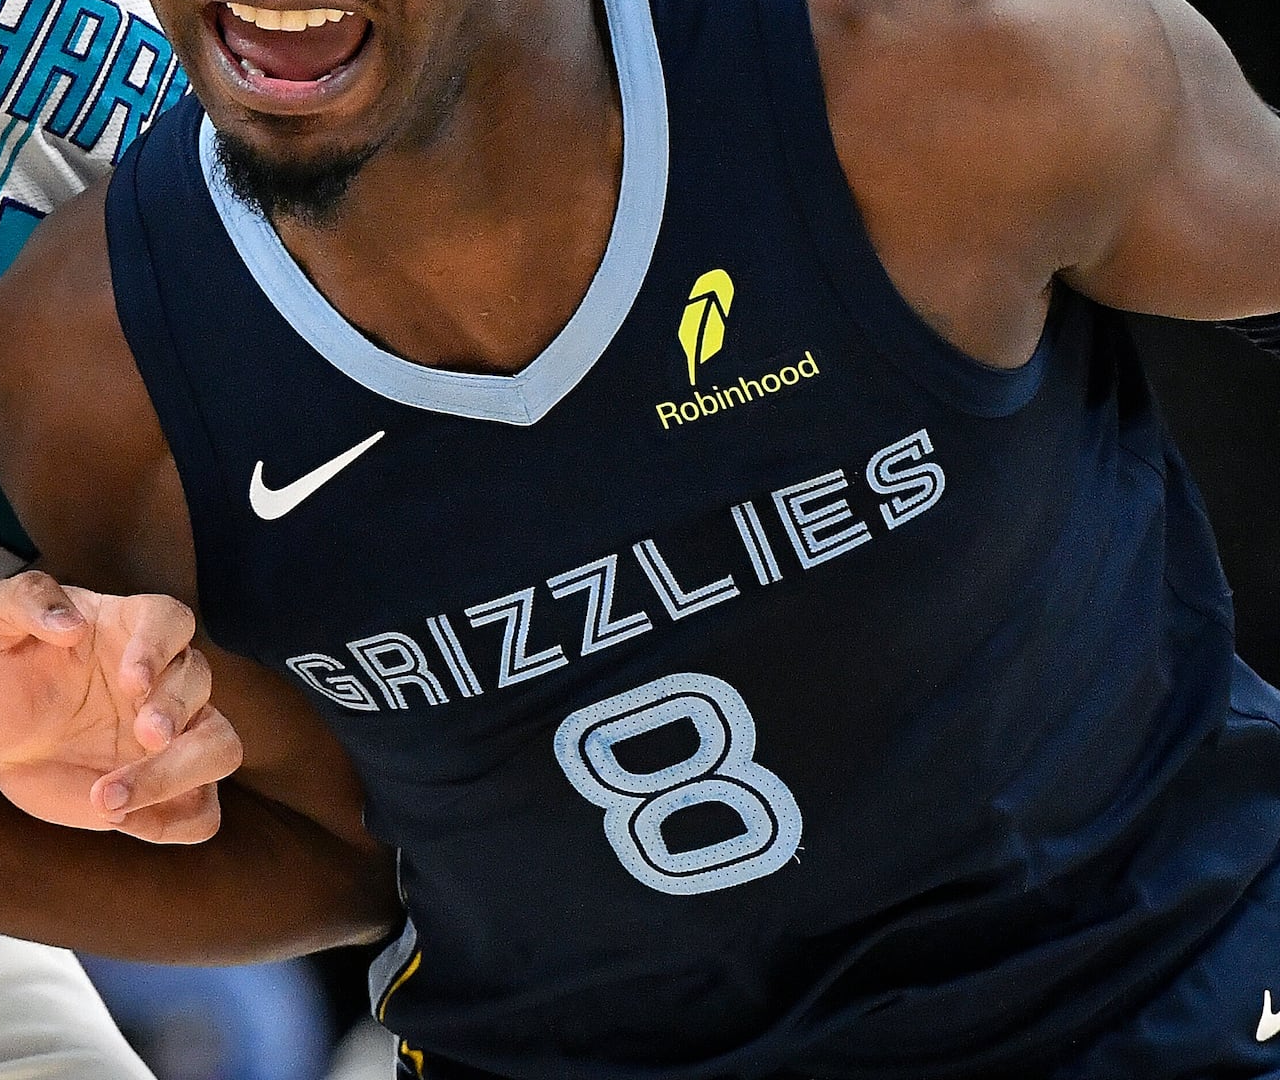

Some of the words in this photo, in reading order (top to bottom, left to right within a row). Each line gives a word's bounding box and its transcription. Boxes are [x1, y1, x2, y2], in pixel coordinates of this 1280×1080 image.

[655, 350, 820, 430] Robinhood
[286, 429, 946, 711] GRIZZLIES
[554, 672, 803, 896] 8
